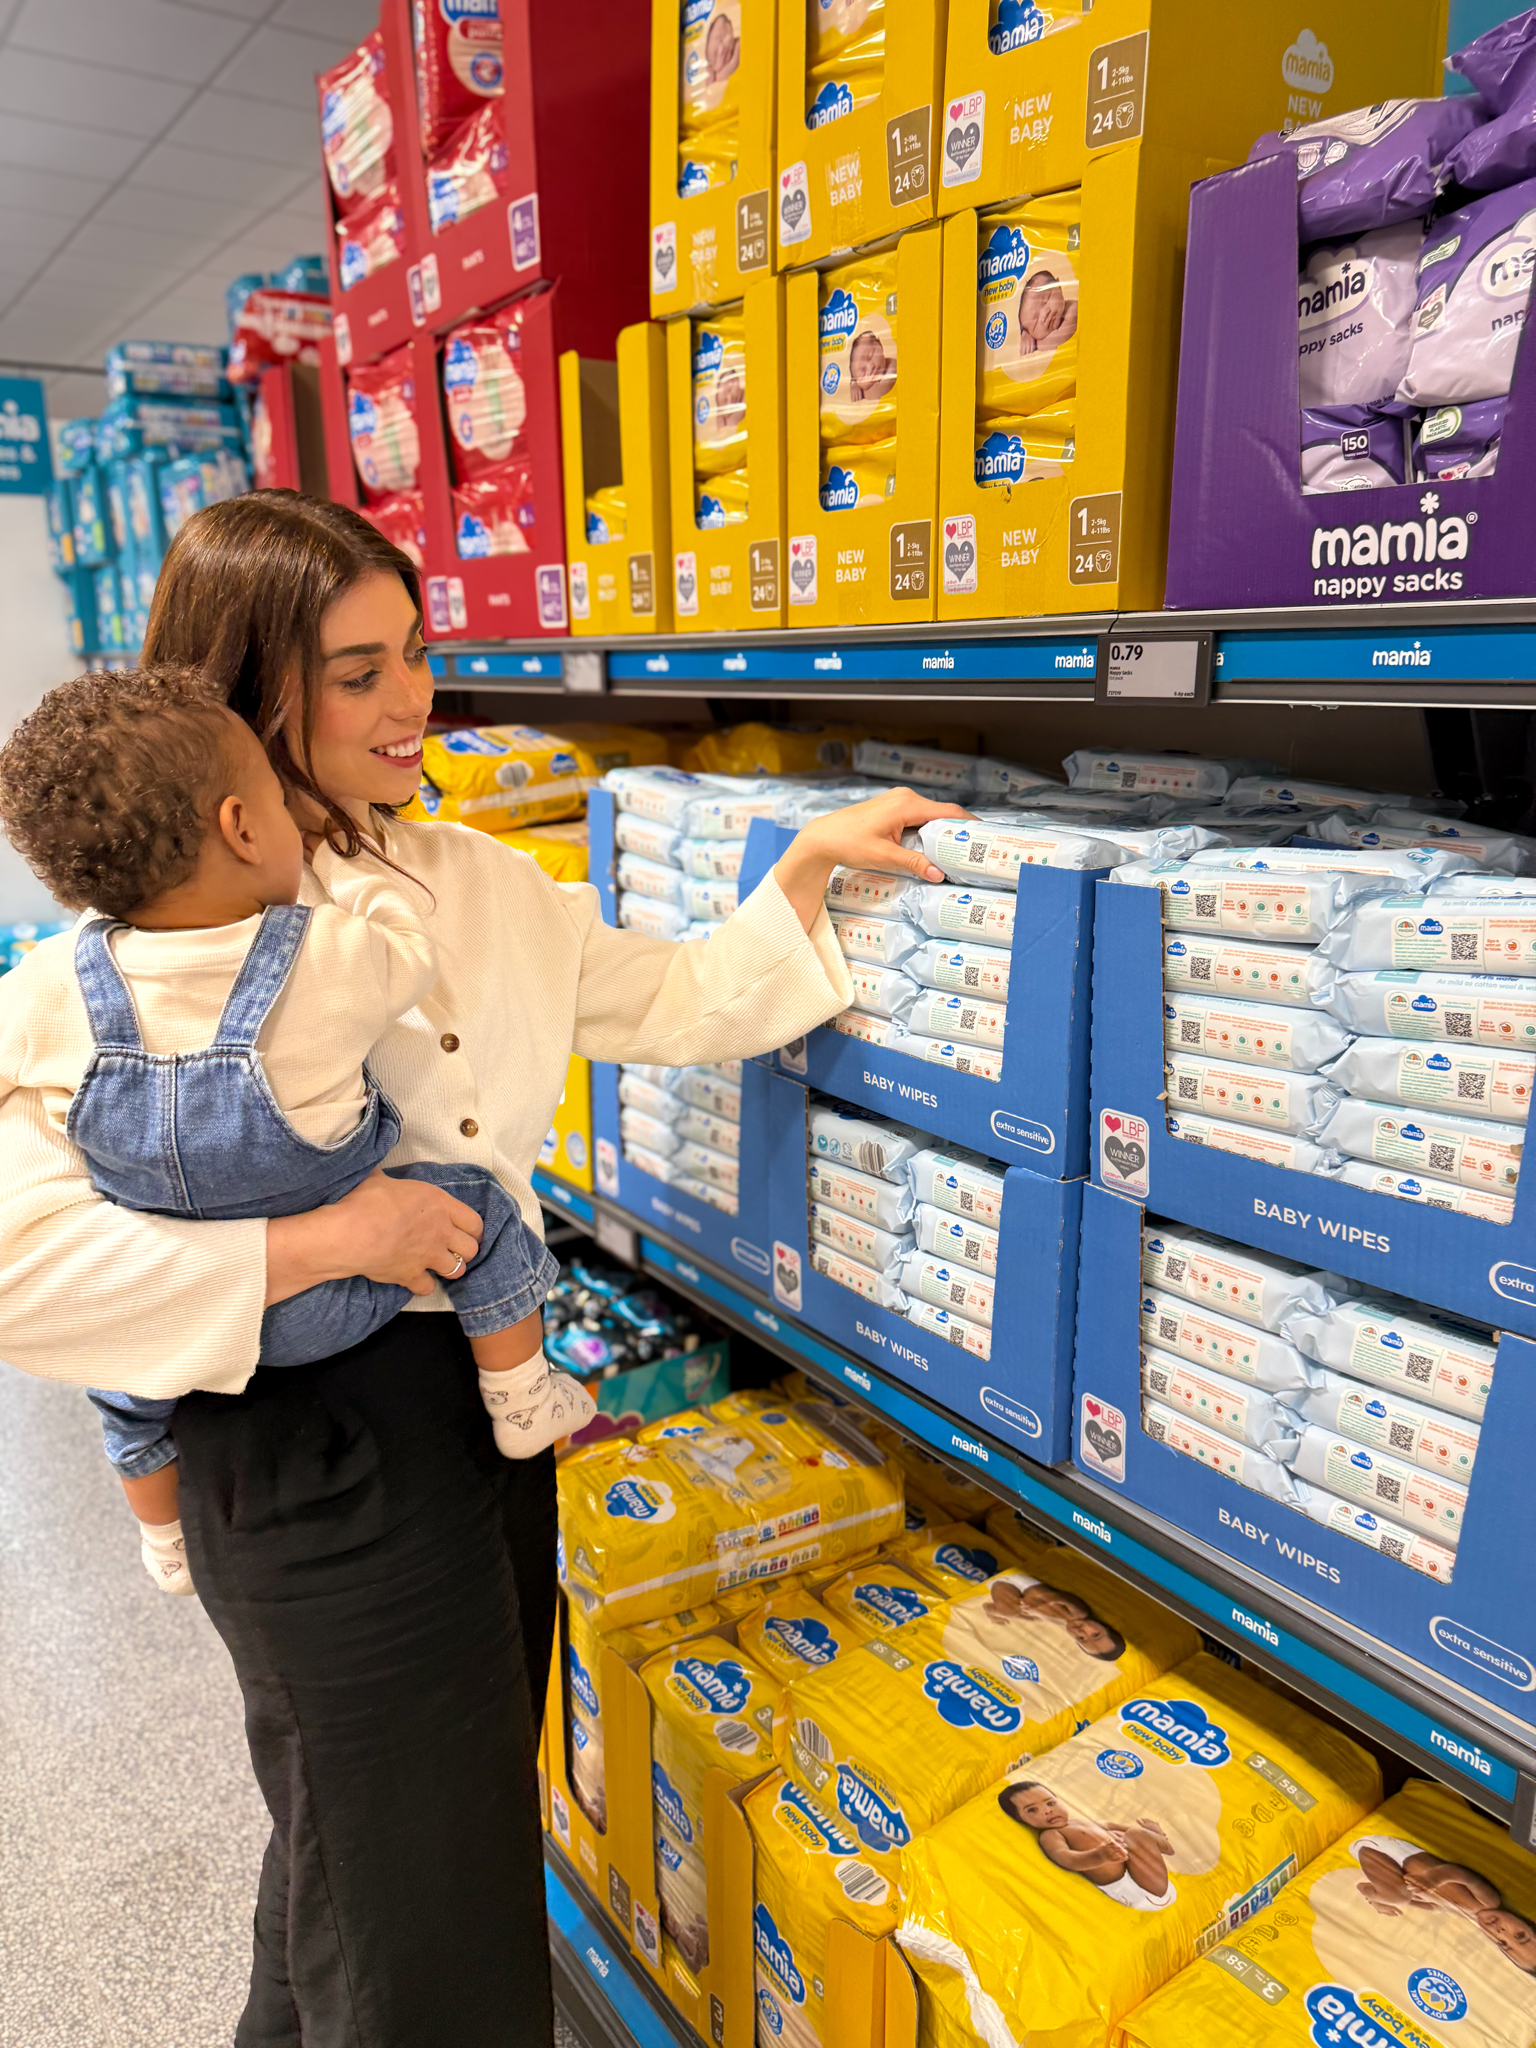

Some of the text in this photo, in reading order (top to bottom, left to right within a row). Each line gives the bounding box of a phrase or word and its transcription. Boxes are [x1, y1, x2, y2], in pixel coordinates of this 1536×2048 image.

[1097, 57, 1109, 90] 1
[1285, 50, 1331, 82] mamia
[963, 96, 983, 117] LBP
[1013, 93, 1053, 121] NEW
[1288, 94, 1323, 118] NEW
[1010, 115, 1054, 145] BABY
[1092, 110, 1114, 135] 24
[891, 128, 902, 157] 1
[950, 136, 976, 151] WINNER
[829, 160, 860, 186] NEW
[894, 171, 911, 195] 24
[830, 179, 863, 207] BABY
[740, 205, 749, 230] 1
[692, 226, 716, 246] NEW
[690, 246, 718, 267] BABY
[740, 243, 754, 262] 24
[978, 236, 1026, 279] mamia
[984, 279, 1016, 297] new baby
[1299, 321, 1364, 358] ppy sacks
[1428, 419, 1449, 429] REDUCED
[1429, 423, 1449, 433] PLASTIC
[1342, 435, 1368, 451] 150
[975, 443, 1022, 476] mamia
[820, 471, 857, 507] mamia
[956, 520, 973, 537] LBP
[1077, 506, 1107, 538] 1 2-5kg
[1091, 526, 1111, 535] 4-11lbs
[1311, 492, 1469, 570] mamia
[896, 533, 904, 558] 1
[1002, 528, 1038, 547] NEW
[752, 550, 760, 572] 1
[837, 549, 865, 565] NEW
[949, 553, 971, 563] WINNER
[1001, 549, 1040, 568] BABY
[1075, 554, 1095, 574] 24
[710, 565, 731, 579] NEW
[836, 567, 867, 583] BABY
[895, 574, 910, 591] 24
[709, 582, 733, 596] BABY
[753, 586, 765, 602] 24
[1314, 568, 1463, 600] nappy sacks
[922, 650, 955, 670] mamia
[1055, 647, 1094, 669] mamia
[1111, 644, 1144, 661] 0.79
[1372, 641, 1431, 666] mamia
[1172, 884, 1190, 893] mamia
[1420, 921, 1443, 933] mamia
[1412, 999, 1437, 1010] mamia
[1426, 1056, 1451, 1069] mamia
[863, 1070, 938, 1109] BABY WIPES
[996, 1120, 1050, 1145] extra sensitive
[1122, 1119, 1145, 1138] LBP
[1401, 1128, 1424, 1140] mamia
[1110, 1147, 1140, 1164] WINNER
[1254, 1198, 1391, 1253] BABY WIPES
[1498, 1276, 1535, 1294] extra
[855, 1320, 930, 1371] BABY WIPES
[844, 1365, 871, 1391] mamia
[985, 1395, 1037, 1431] extra sensitive
[1101, 1406, 1122, 1427] LBP
[952, 1434, 989, 1462] mamia
[1089, 1430, 1118, 1452] WINNER
[1073, 1510, 1112, 1544] mamia
[1218, 1507, 1341, 1584] BABY WIPES
[1232, 1607, 1280, 1646] mamia
[773, 1618, 831, 1665] mamia
[894, 1658, 910, 1670] 3
[1439, 1627, 1528, 1681] extra sensitive
[688, 1660, 743, 1710] mamia
[966, 1668, 994, 1688] baby
[673, 1676, 706, 1709] new baby
[932, 1665, 1012, 1727] mamia
[993, 1687, 1016, 1704] new
[756, 1708, 772, 1722] 3
[1127, 1724, 1184, 1761] new baby
[1129, 1702, 1223, 1761] mamia
[798, 1750, 812, 1766] 58
[1430, 1730, 1491, 1776] mamia
[814, 1769, 829, 1788] 3
[1249, 1755, 1298, 1795] 3 58
[839, 1772, 904, 1842] mamia
[781, 1805, 824, 1847] new baby
[587, 1946, 610, 1978] mamia
[1226, 1953, 1249, 1973] 58
[1425, 1968, 1457, 1989] ZONES
[1262, 1980, 1284, 2000] 3
[1362, 1998, 1405, 2035] baby
